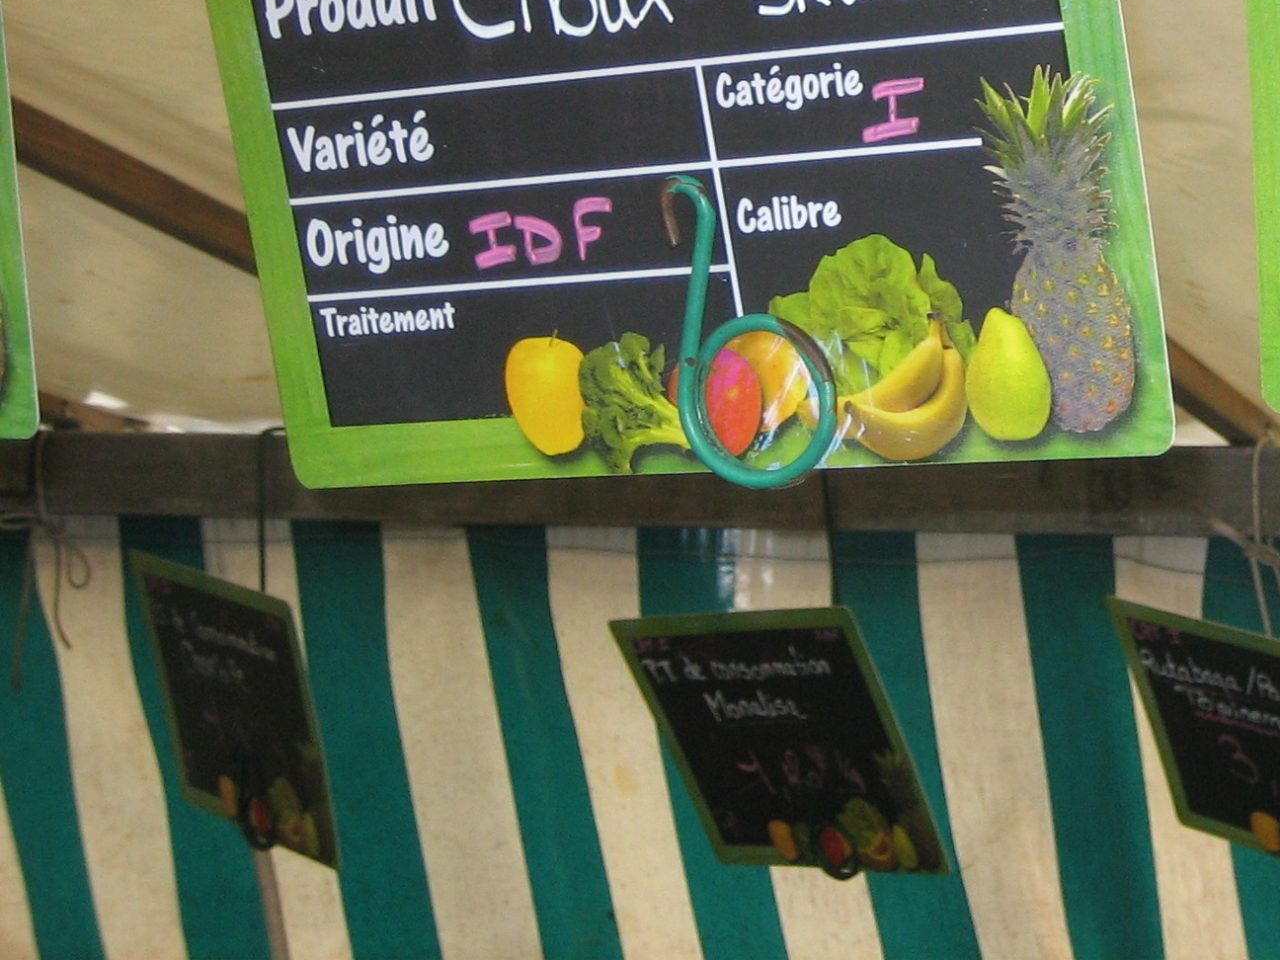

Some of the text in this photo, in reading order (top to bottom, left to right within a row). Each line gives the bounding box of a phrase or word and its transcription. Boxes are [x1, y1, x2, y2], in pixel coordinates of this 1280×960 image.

[714, 62, 864, 110] Catégorie
[287, 110, 434, 173] Variété
[306, 196, 613, 274] Origine IDF
[737, 195, 842, 233] Calibre
[320, 301, 456, 338] Traitement
